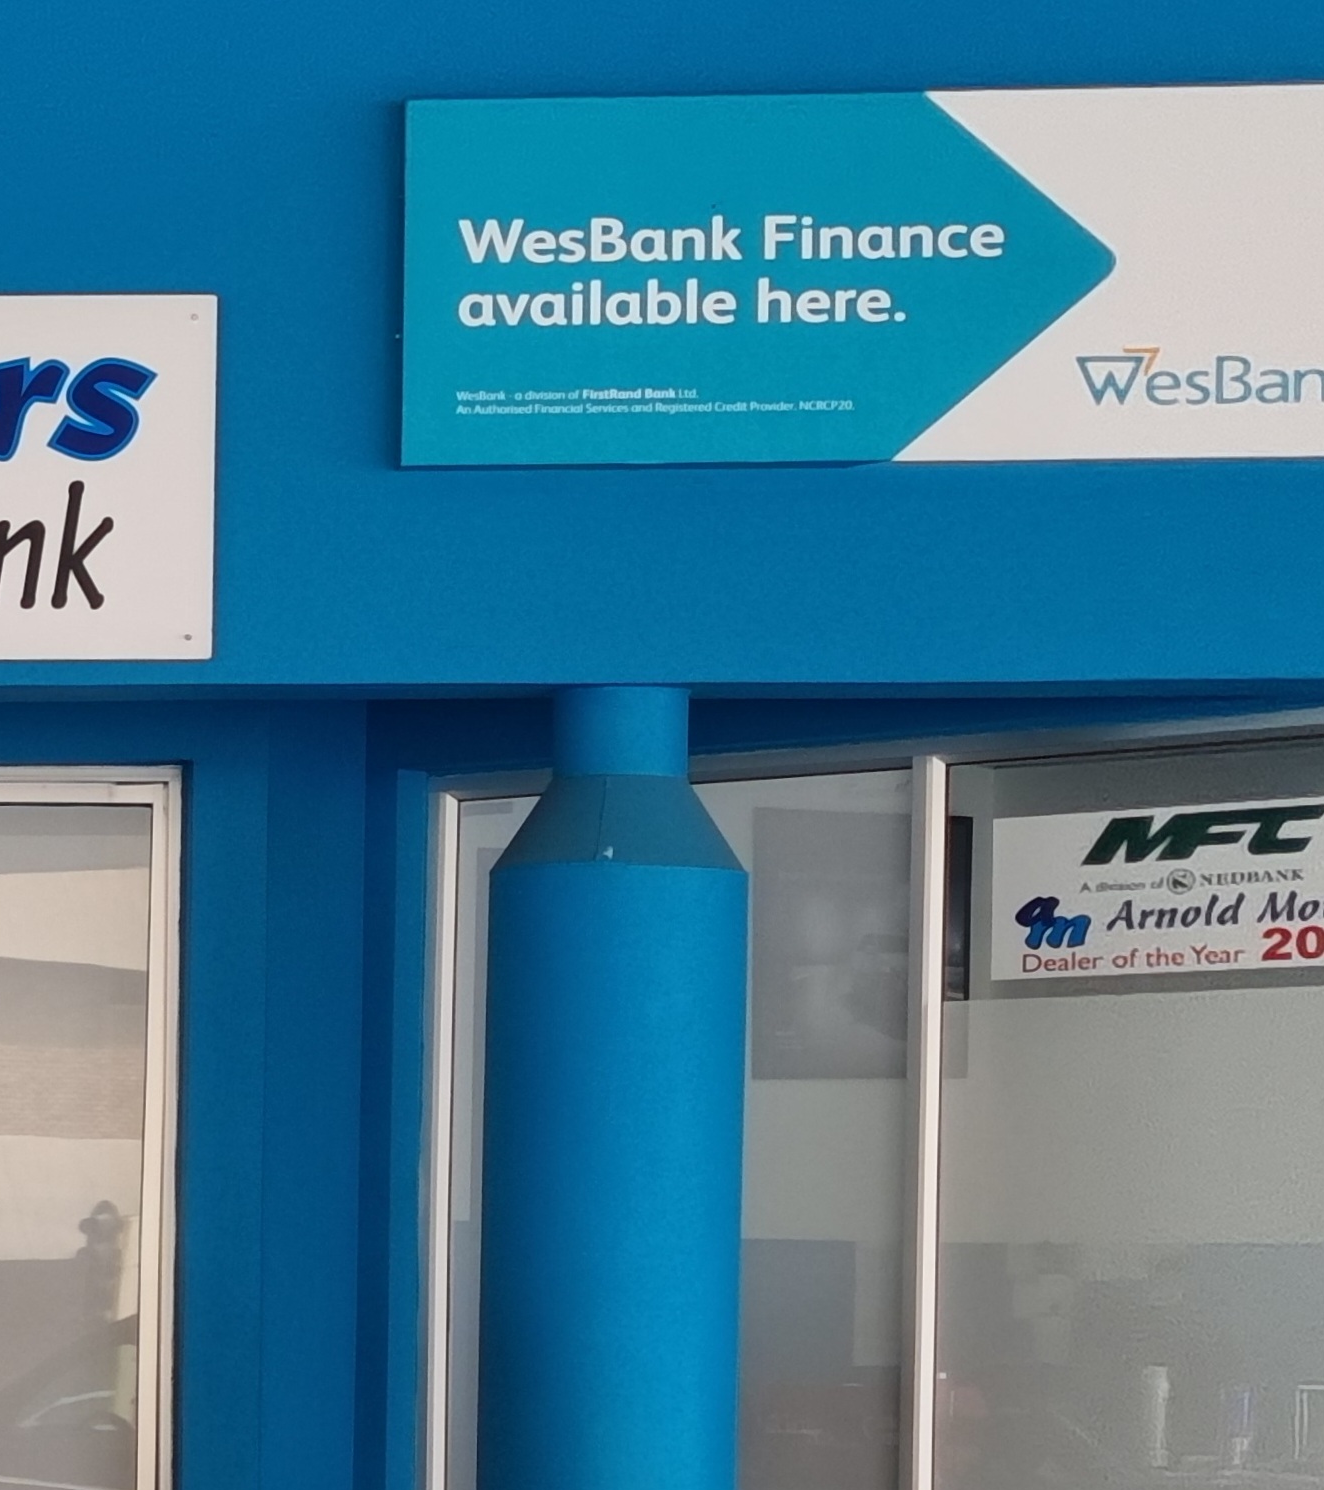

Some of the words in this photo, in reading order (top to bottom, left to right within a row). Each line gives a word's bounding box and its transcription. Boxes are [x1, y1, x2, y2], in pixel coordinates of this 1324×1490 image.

[458, 214, 743, 266] WesBank
[763, 211, 1006, 262] Finance
[457, 277, 738, 328] available
[756, 276, 908, 324] here.
[456, 391, 507, 402] WesBank
[525, 390, 566, 401] division
[567, 390, 581, 400] of
[582, 389, 642, 400] FirstRand
[644, 388, 676, 399] Bank
[456, 404, 472, 415] An
[473, 404, 533, 415] Authorised
[534, 403, 584, 414] Financial
[585, 403, 630, 414] Services
[631, 403, 653, 413] and
[655, 402, 713, 415] Registered
[714, 402, 748, 412] Credit
[1080, 803, 1324, 866] MFC
[1199, 868, 1306, 887] NEDBANK
[1106, 891, 1246, 932] Arnold
[1256, 890, 1324, 924] Mo
[1022, 951, 1105, 973] Dealer
[1111, 948, 1140, 969] of
[1146, 946, 1185, 968] the
[1190, 944, 1246, 965] Year
